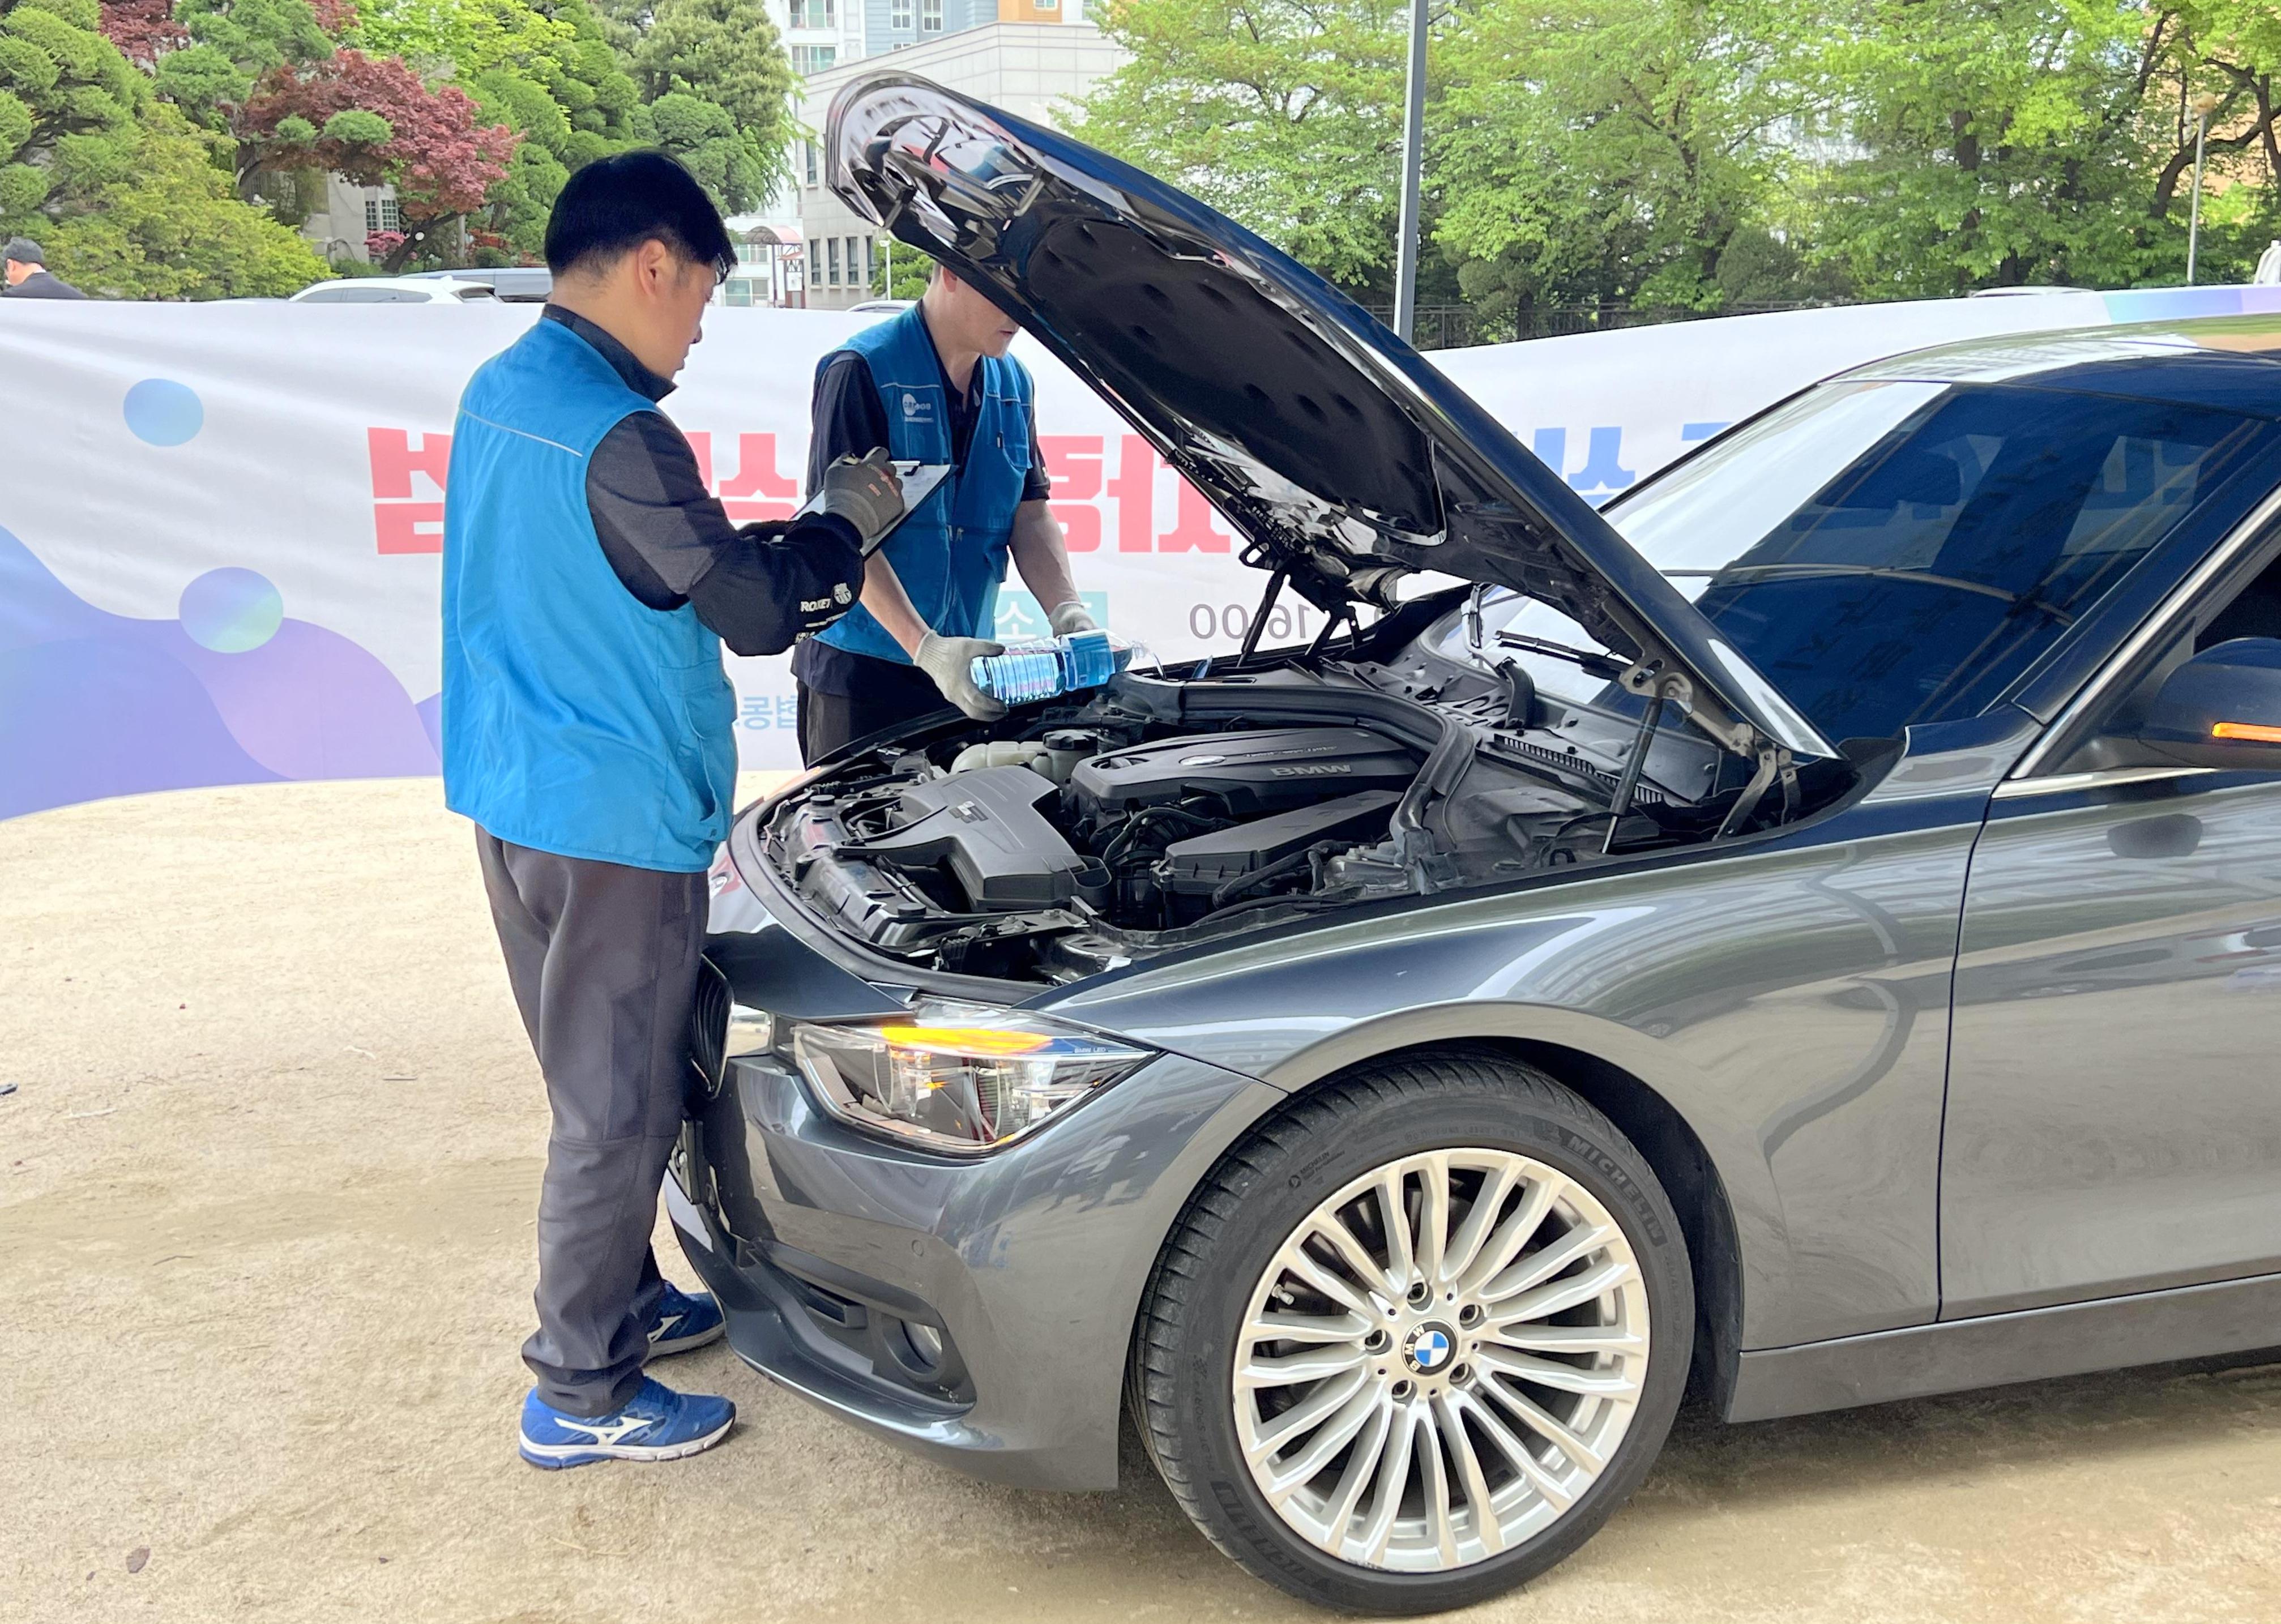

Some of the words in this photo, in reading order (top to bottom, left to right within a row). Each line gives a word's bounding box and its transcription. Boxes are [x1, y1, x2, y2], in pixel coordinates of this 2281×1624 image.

[1270, 764, 1352, 777] BMW
[1566, 1134, 1664, 1240] MICHELIN
[1404, 1324, 1425, 1371] BMW
